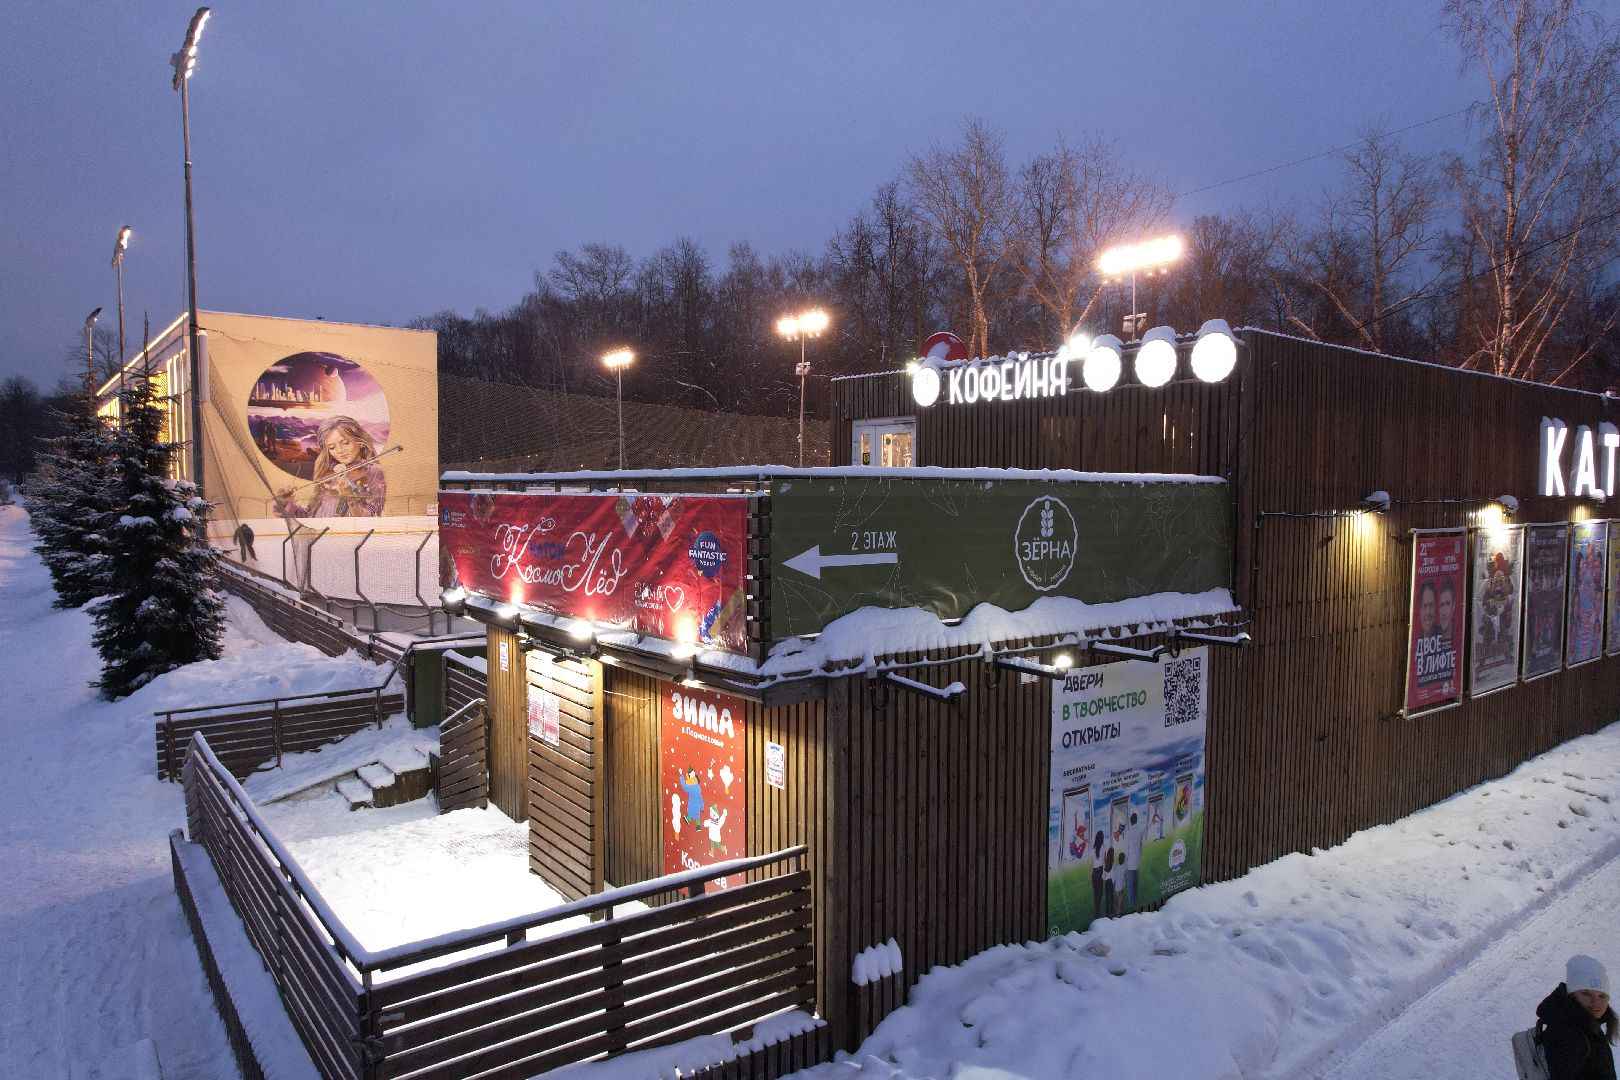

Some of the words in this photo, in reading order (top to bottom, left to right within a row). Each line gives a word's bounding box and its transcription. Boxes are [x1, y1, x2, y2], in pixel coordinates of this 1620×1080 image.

[948, 353, 1068, 405] КОФЕЙНЯ
[699, 541, 716, 550] FUN
[850, 531, 859, 551] 2
[863, 529, 898, 550] ЭТАЖ
[1021, 536, 1072, 561] ЗЁРНА
[688, 549, 728, 562] FANTASTIC
[1416, 635, 1442, 660] ДВОЕ
[1417, 656, 1424, 676] В
[1425, 650, 1457, 674] ЛИФТЕ
[1063, 672, 1104, 693] ДВЕРИ
[671, 692, 735, 739] ЗИМА
[1063, 704, 1070, 721] В
[1074, 690, 1147, 720] ТВОРЧЕСТВО
[1062, 722, 1121, 748] ОТКРЫТЫ
